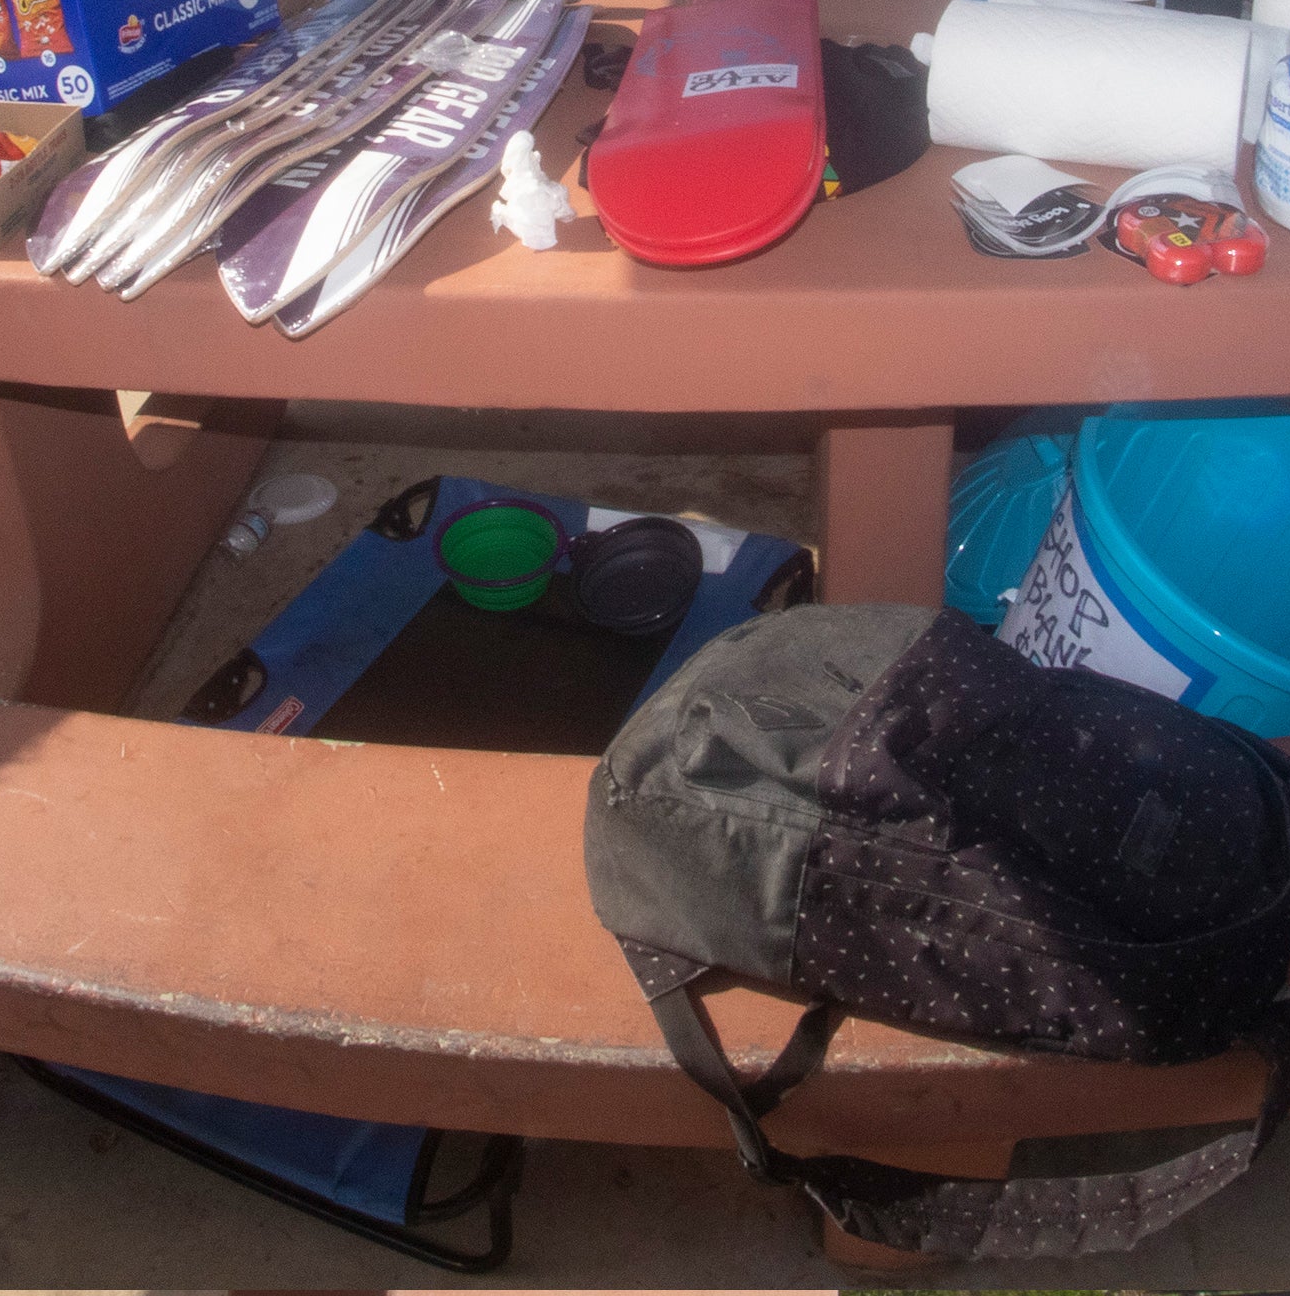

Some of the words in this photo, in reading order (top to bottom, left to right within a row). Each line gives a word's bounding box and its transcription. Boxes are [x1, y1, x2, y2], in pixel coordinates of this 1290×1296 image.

[22, 85, 49, 100] MIX
[61, 75, 88, 96] 50
[372, 81, 489, 149] GEAR.
